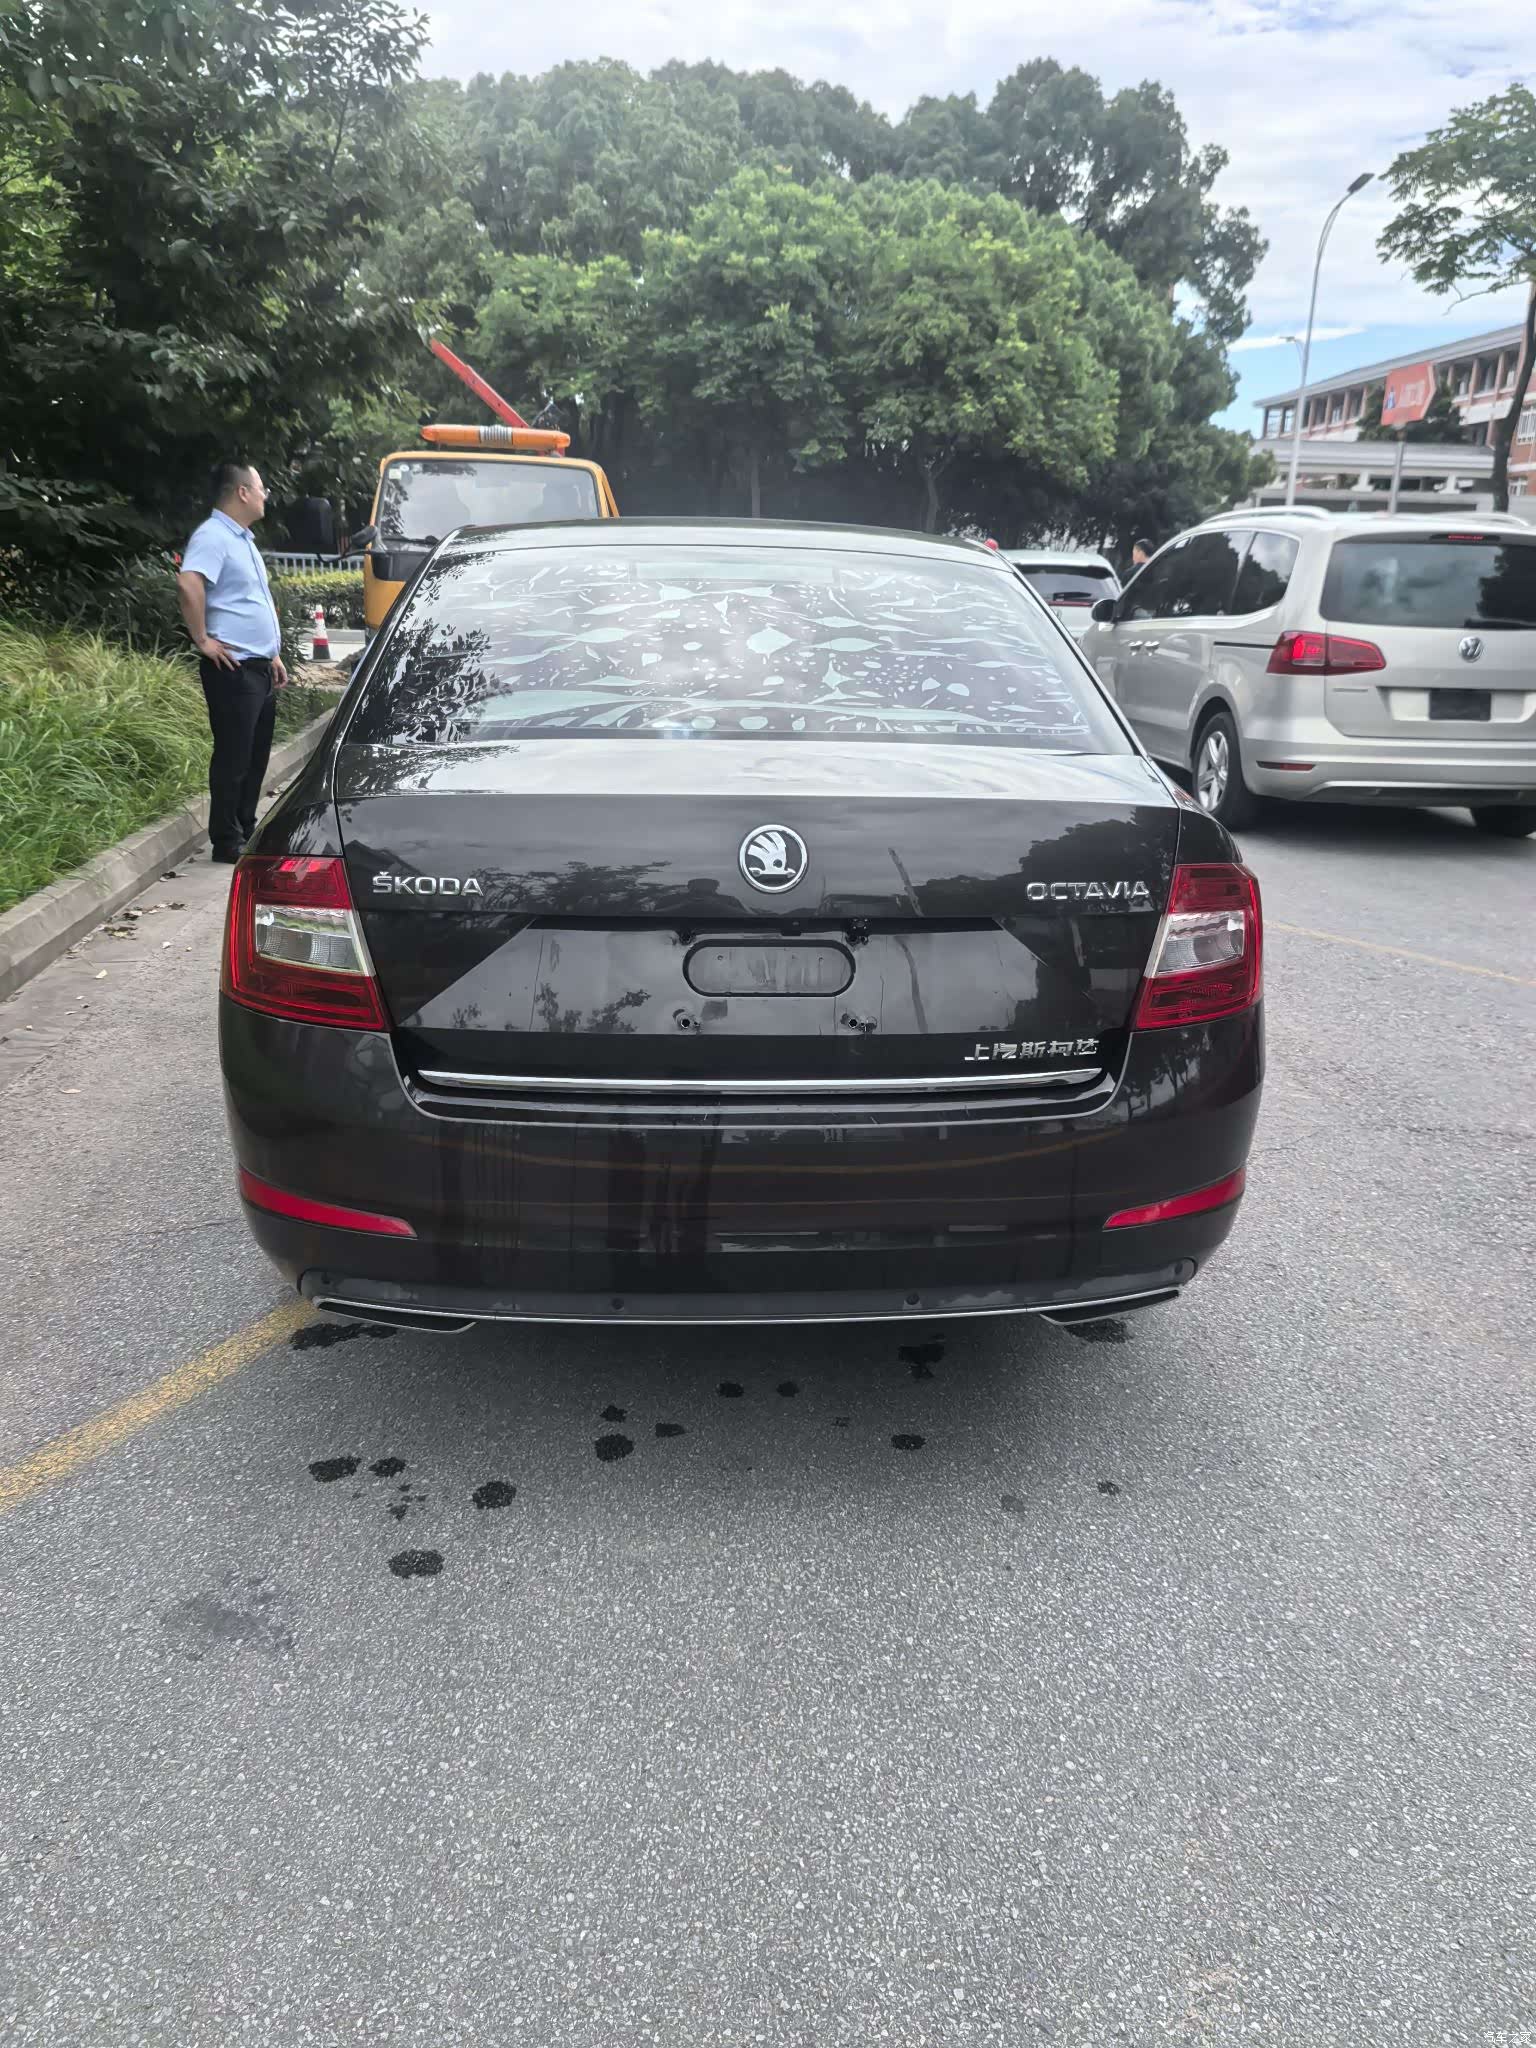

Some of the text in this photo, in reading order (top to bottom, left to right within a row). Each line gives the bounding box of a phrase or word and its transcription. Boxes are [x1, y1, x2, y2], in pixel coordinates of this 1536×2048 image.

[372, 871, 484, 897] ŠKODA
[1026, 881, 1150, 900] OCTAVIA
[964, 1038, 1099, 1061] 上汽斯柯达
